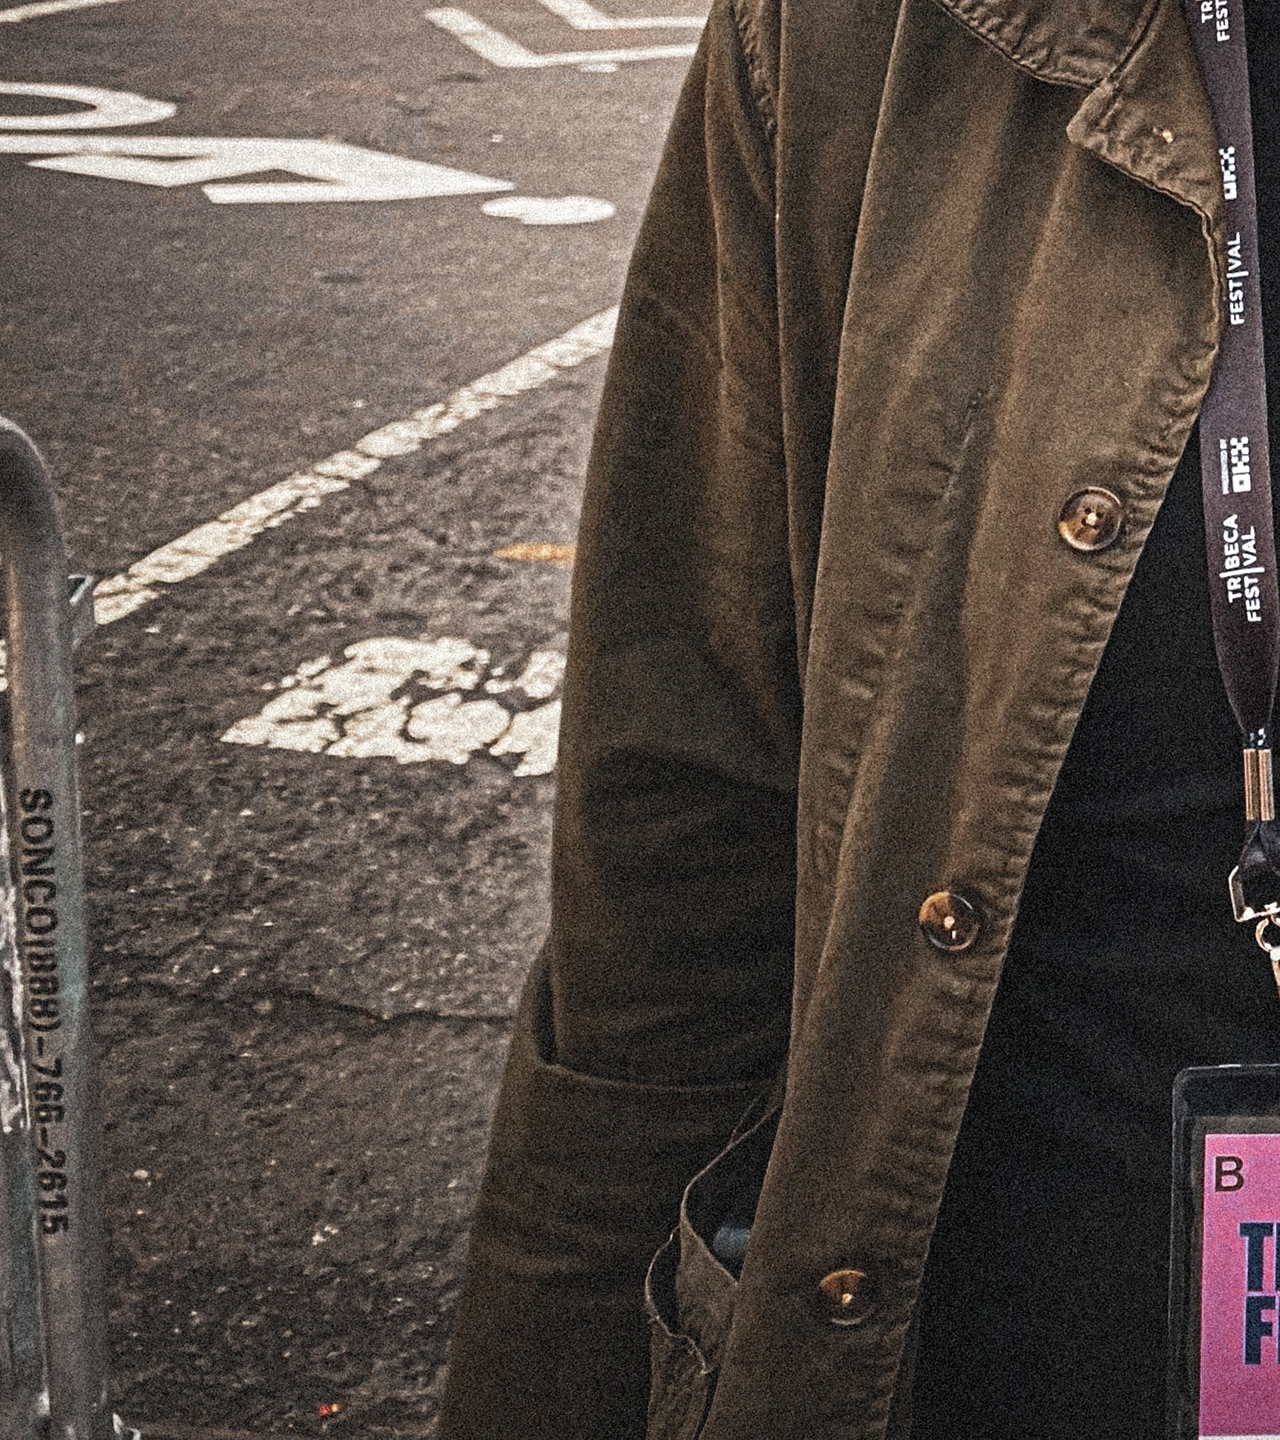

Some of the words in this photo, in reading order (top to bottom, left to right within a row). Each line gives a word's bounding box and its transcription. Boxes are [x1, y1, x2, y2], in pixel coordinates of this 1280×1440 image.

[1230, 231, 1250, 326] FESTIVAL
[1219, 513, 1240, 604] TRIBECA
[1242, 525, 1265, 623] FESTIVAL
[1214, 1155, 1245, 1193] B
